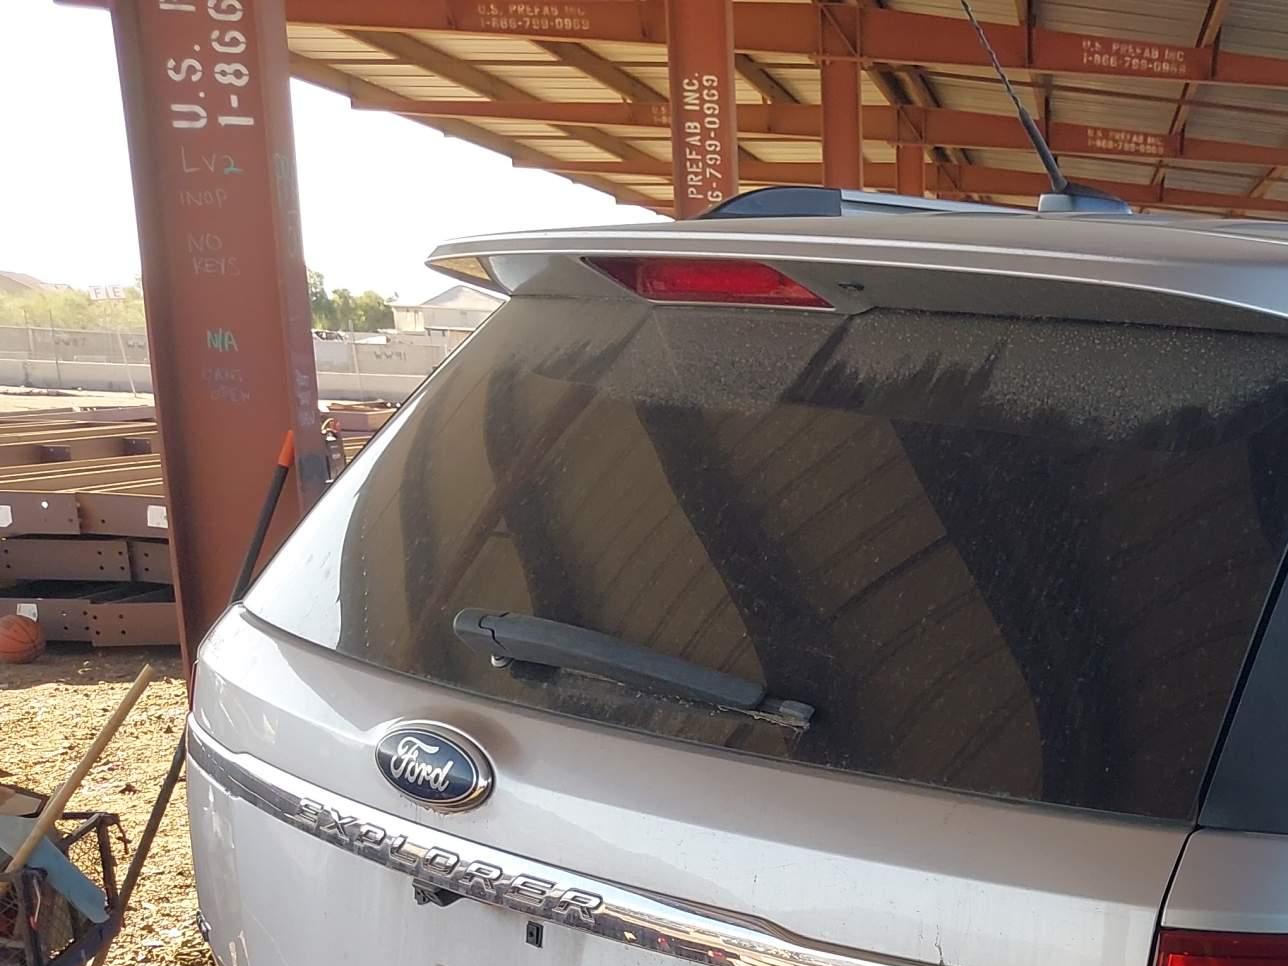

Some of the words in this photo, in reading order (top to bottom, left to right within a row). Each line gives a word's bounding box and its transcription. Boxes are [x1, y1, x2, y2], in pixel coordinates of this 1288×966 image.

[167, 44, 208, 129] U.S.
[683, 72, 700, 111] INC.
[685, 121, 704, 199] PREFAB
[702, 74, 723, 207] 6-799-0969
[187, 232, 223, 252] NO
[192, 255, 240, 276] KEYS
[389, 735, 454, 793] Ford
[296, 796, 604, 926] EXPLORER
